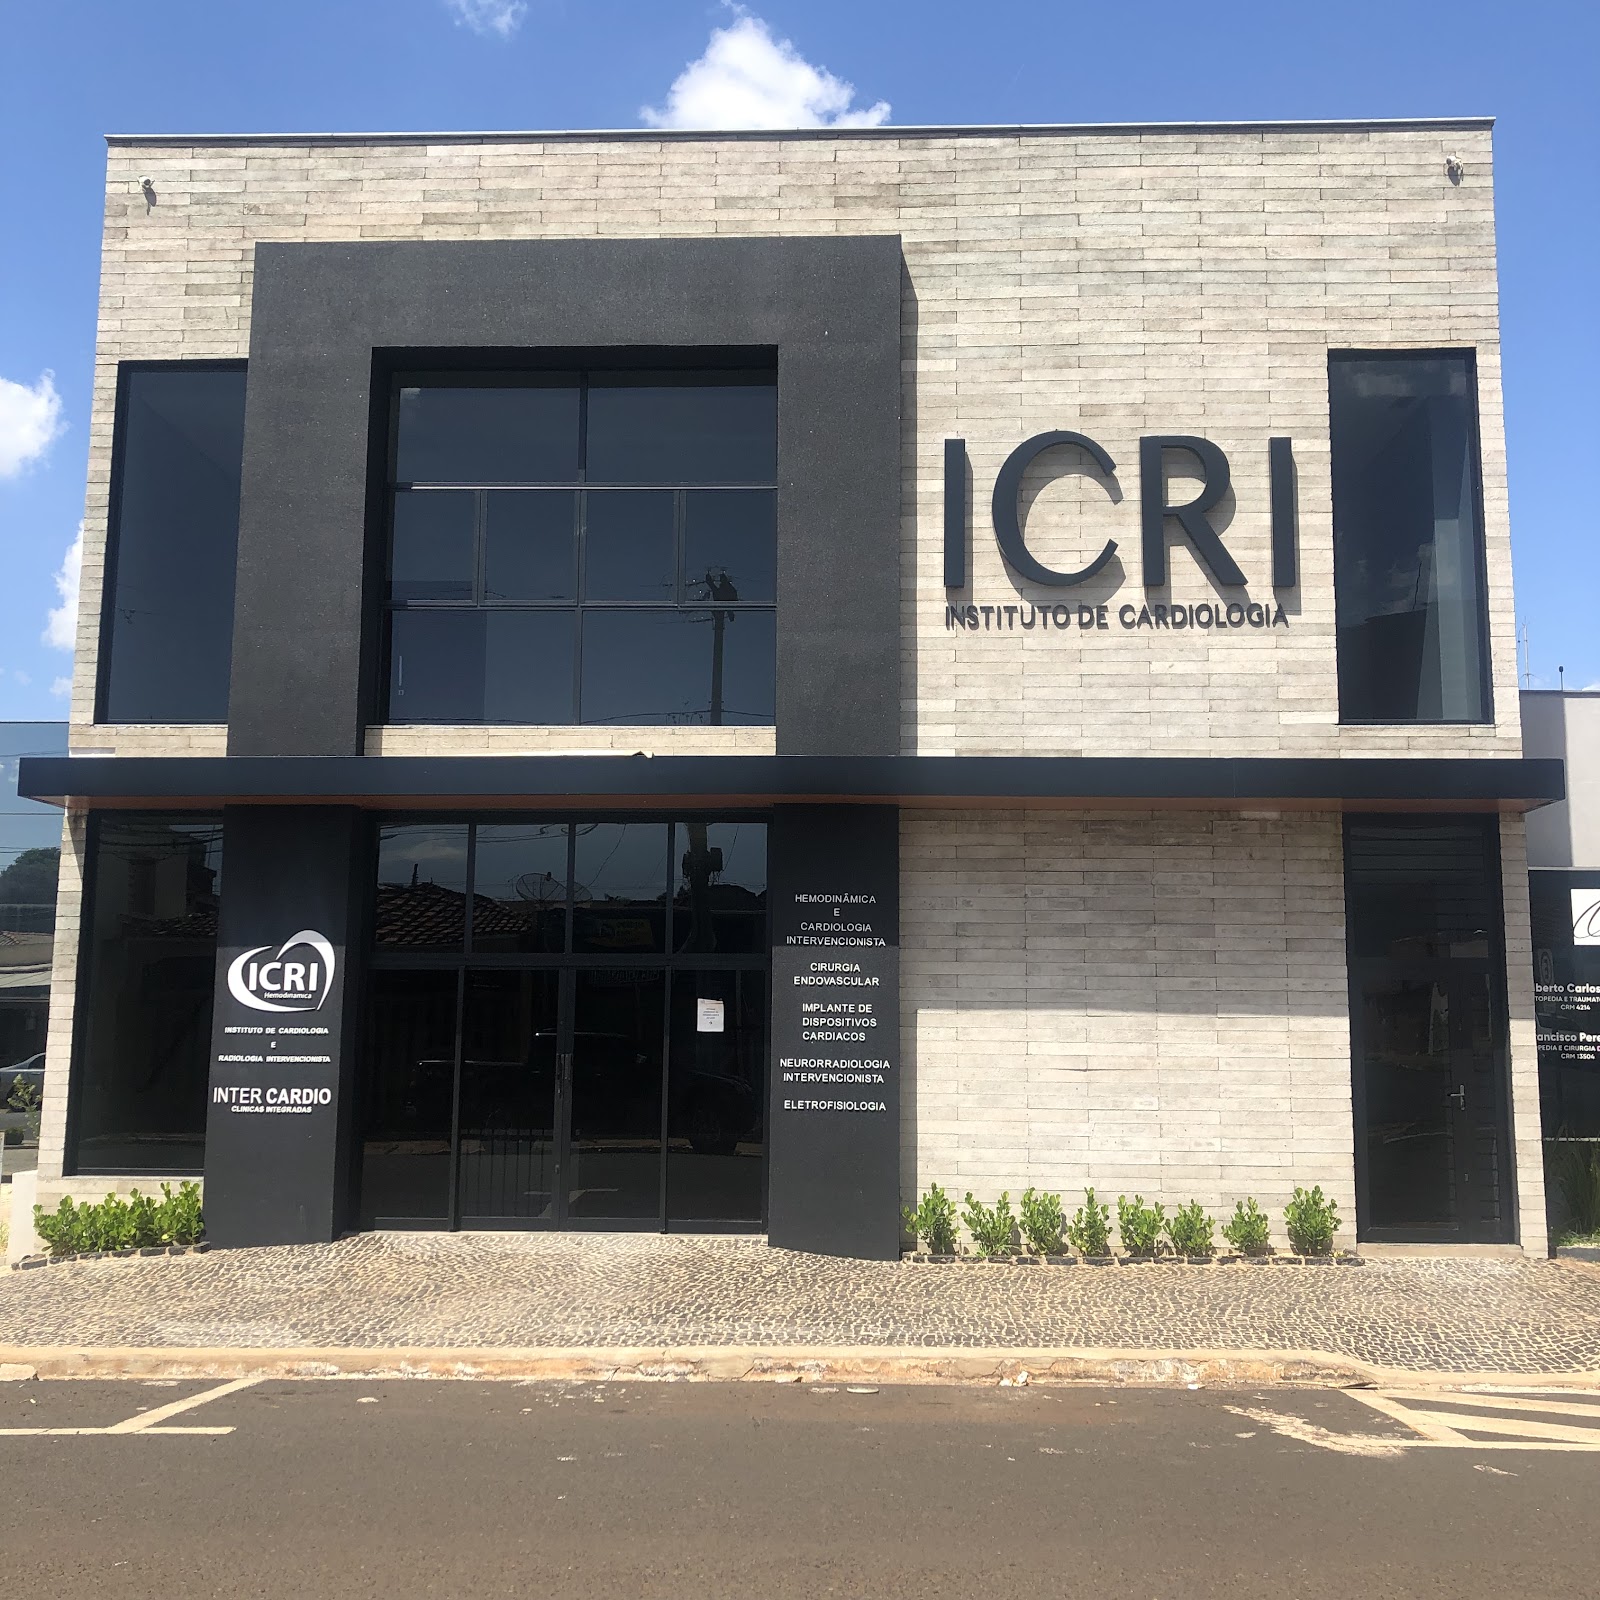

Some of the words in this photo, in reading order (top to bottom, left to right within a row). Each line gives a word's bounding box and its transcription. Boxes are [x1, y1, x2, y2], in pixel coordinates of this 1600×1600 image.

[944, 430, 1297, 588] ICRI
[945, 604, 1071, 629] INSTITUTO
[1079, 604, 1109, 629] DE
[1119, 603, 1290, 629] CARDIOLOGIA
[795, 892, 876, 904] HEMODINÂMICA
[833, 908, 841, 917] E
[800, 922, 872, 932] CARDIOLOGIA
[786, 936, 886, 946] INTERVENCIONISTA
[810, 963, 861, 972] CIRURGIA
[248, 962, 319, 991] ICRI
[793, 976, 880, 986] ENDOVASCULAR
[1566, 983, 1600, 994] Carlos
[802, 1003, 856, 1013] IMPLANTE
[858, 1004, 873, 1014] DE
[802, 1017, 877, 1027] DISPOSITIVOS
[265, 1027, 276, 1035] DE
[278, 1027, 329, 1035] CARDIOLOGIA
[802, 1032, 866, 1041] CARDIACOS
[270, 1041, 277, 1049] E
[218, 1055, 264, 1063] RADIOLOGIA
[266, 1055, 332, 1063] INTERVENCIONISTA
[779, 1058, 891, 1069] NEURORRADIOLOGIA
[783, 1073, 885, 1084] INTERVENCIONISTA
[213, 1087, 262, 1103] INTER
[265, 1088, 332, 1105] CARDIO
[265, 1106, 313, 1114] INTEGRADAS
[784, 1100, 886, 1111] ELETROFISIOLOGIA
